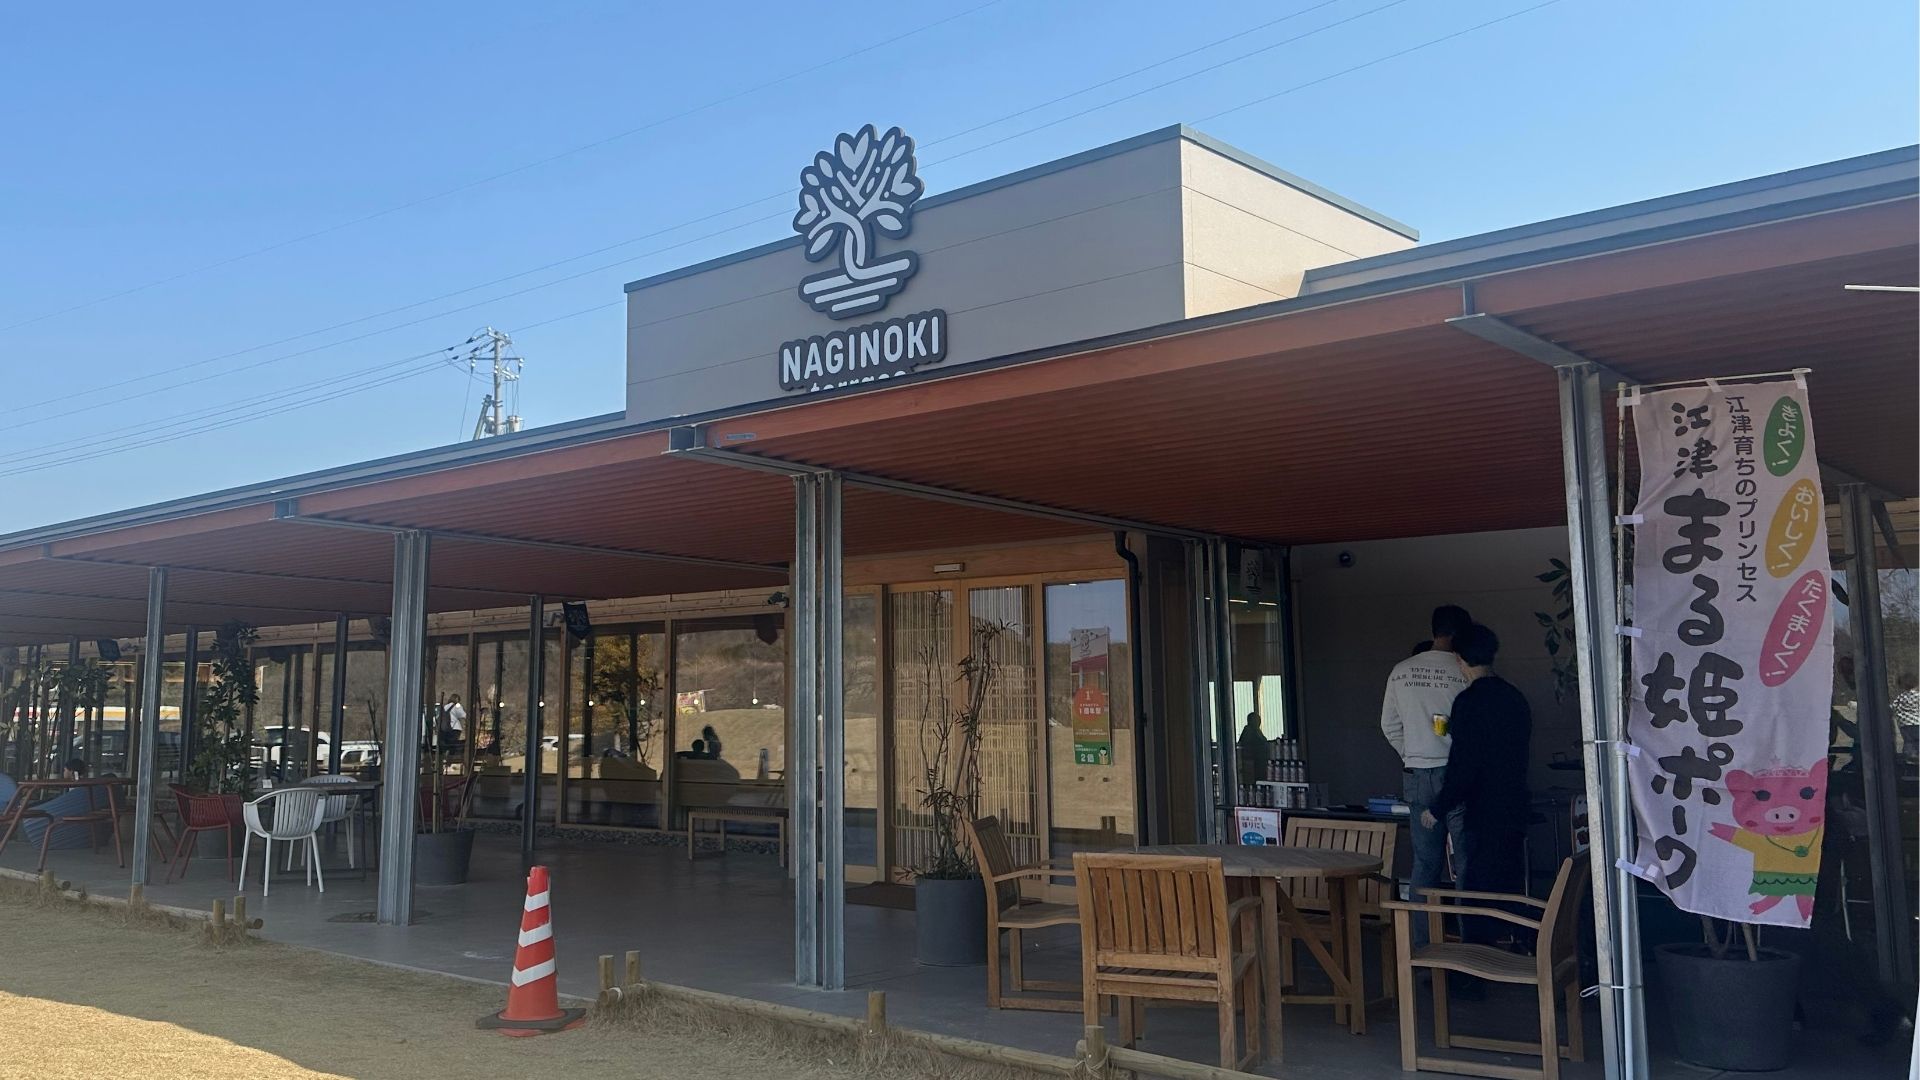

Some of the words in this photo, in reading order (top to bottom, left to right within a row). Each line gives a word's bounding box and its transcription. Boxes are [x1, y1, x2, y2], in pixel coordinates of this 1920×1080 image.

[782, 315, 940, 385] NAGINOKI
[1725, 395, 1759, 603] 江津育ちのプリンセス
